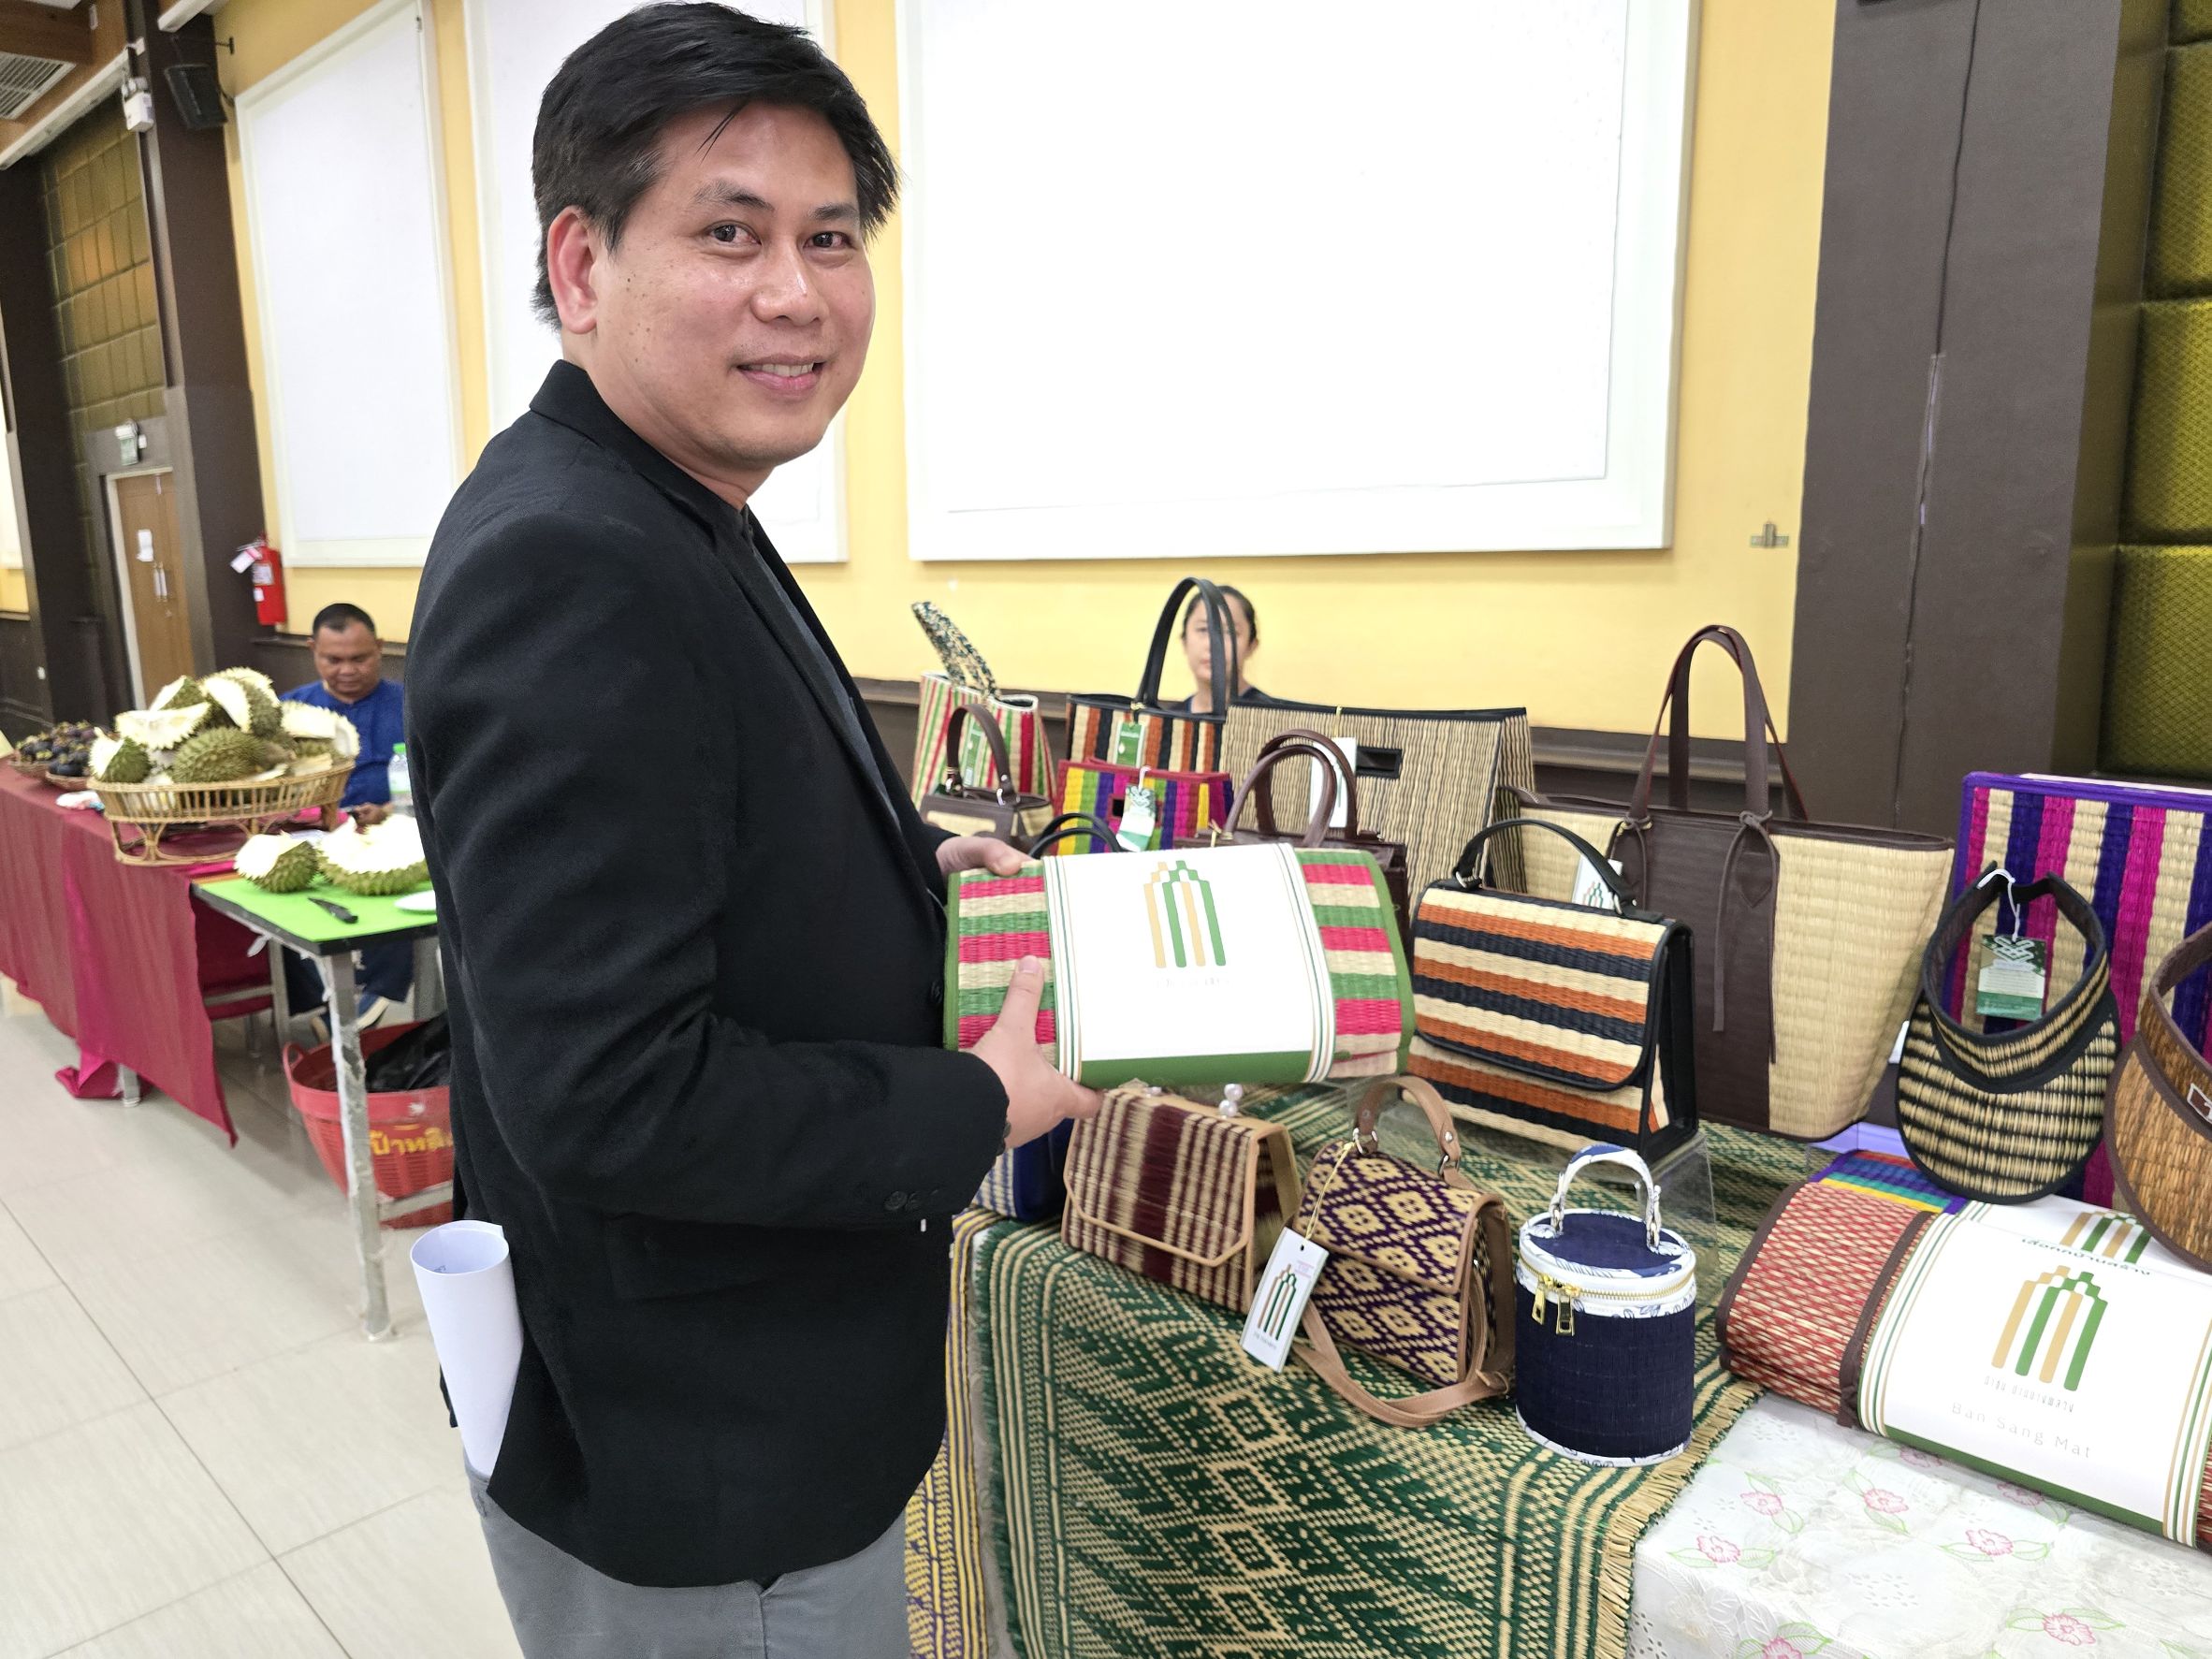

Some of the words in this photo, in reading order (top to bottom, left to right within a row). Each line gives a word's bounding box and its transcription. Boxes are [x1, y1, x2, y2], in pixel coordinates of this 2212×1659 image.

[1951, 1402, 1986, 1423] Ban
[1996, 1416, 2045, 1446] Sang
[2055, 1435, 2089, 1459] Mat
